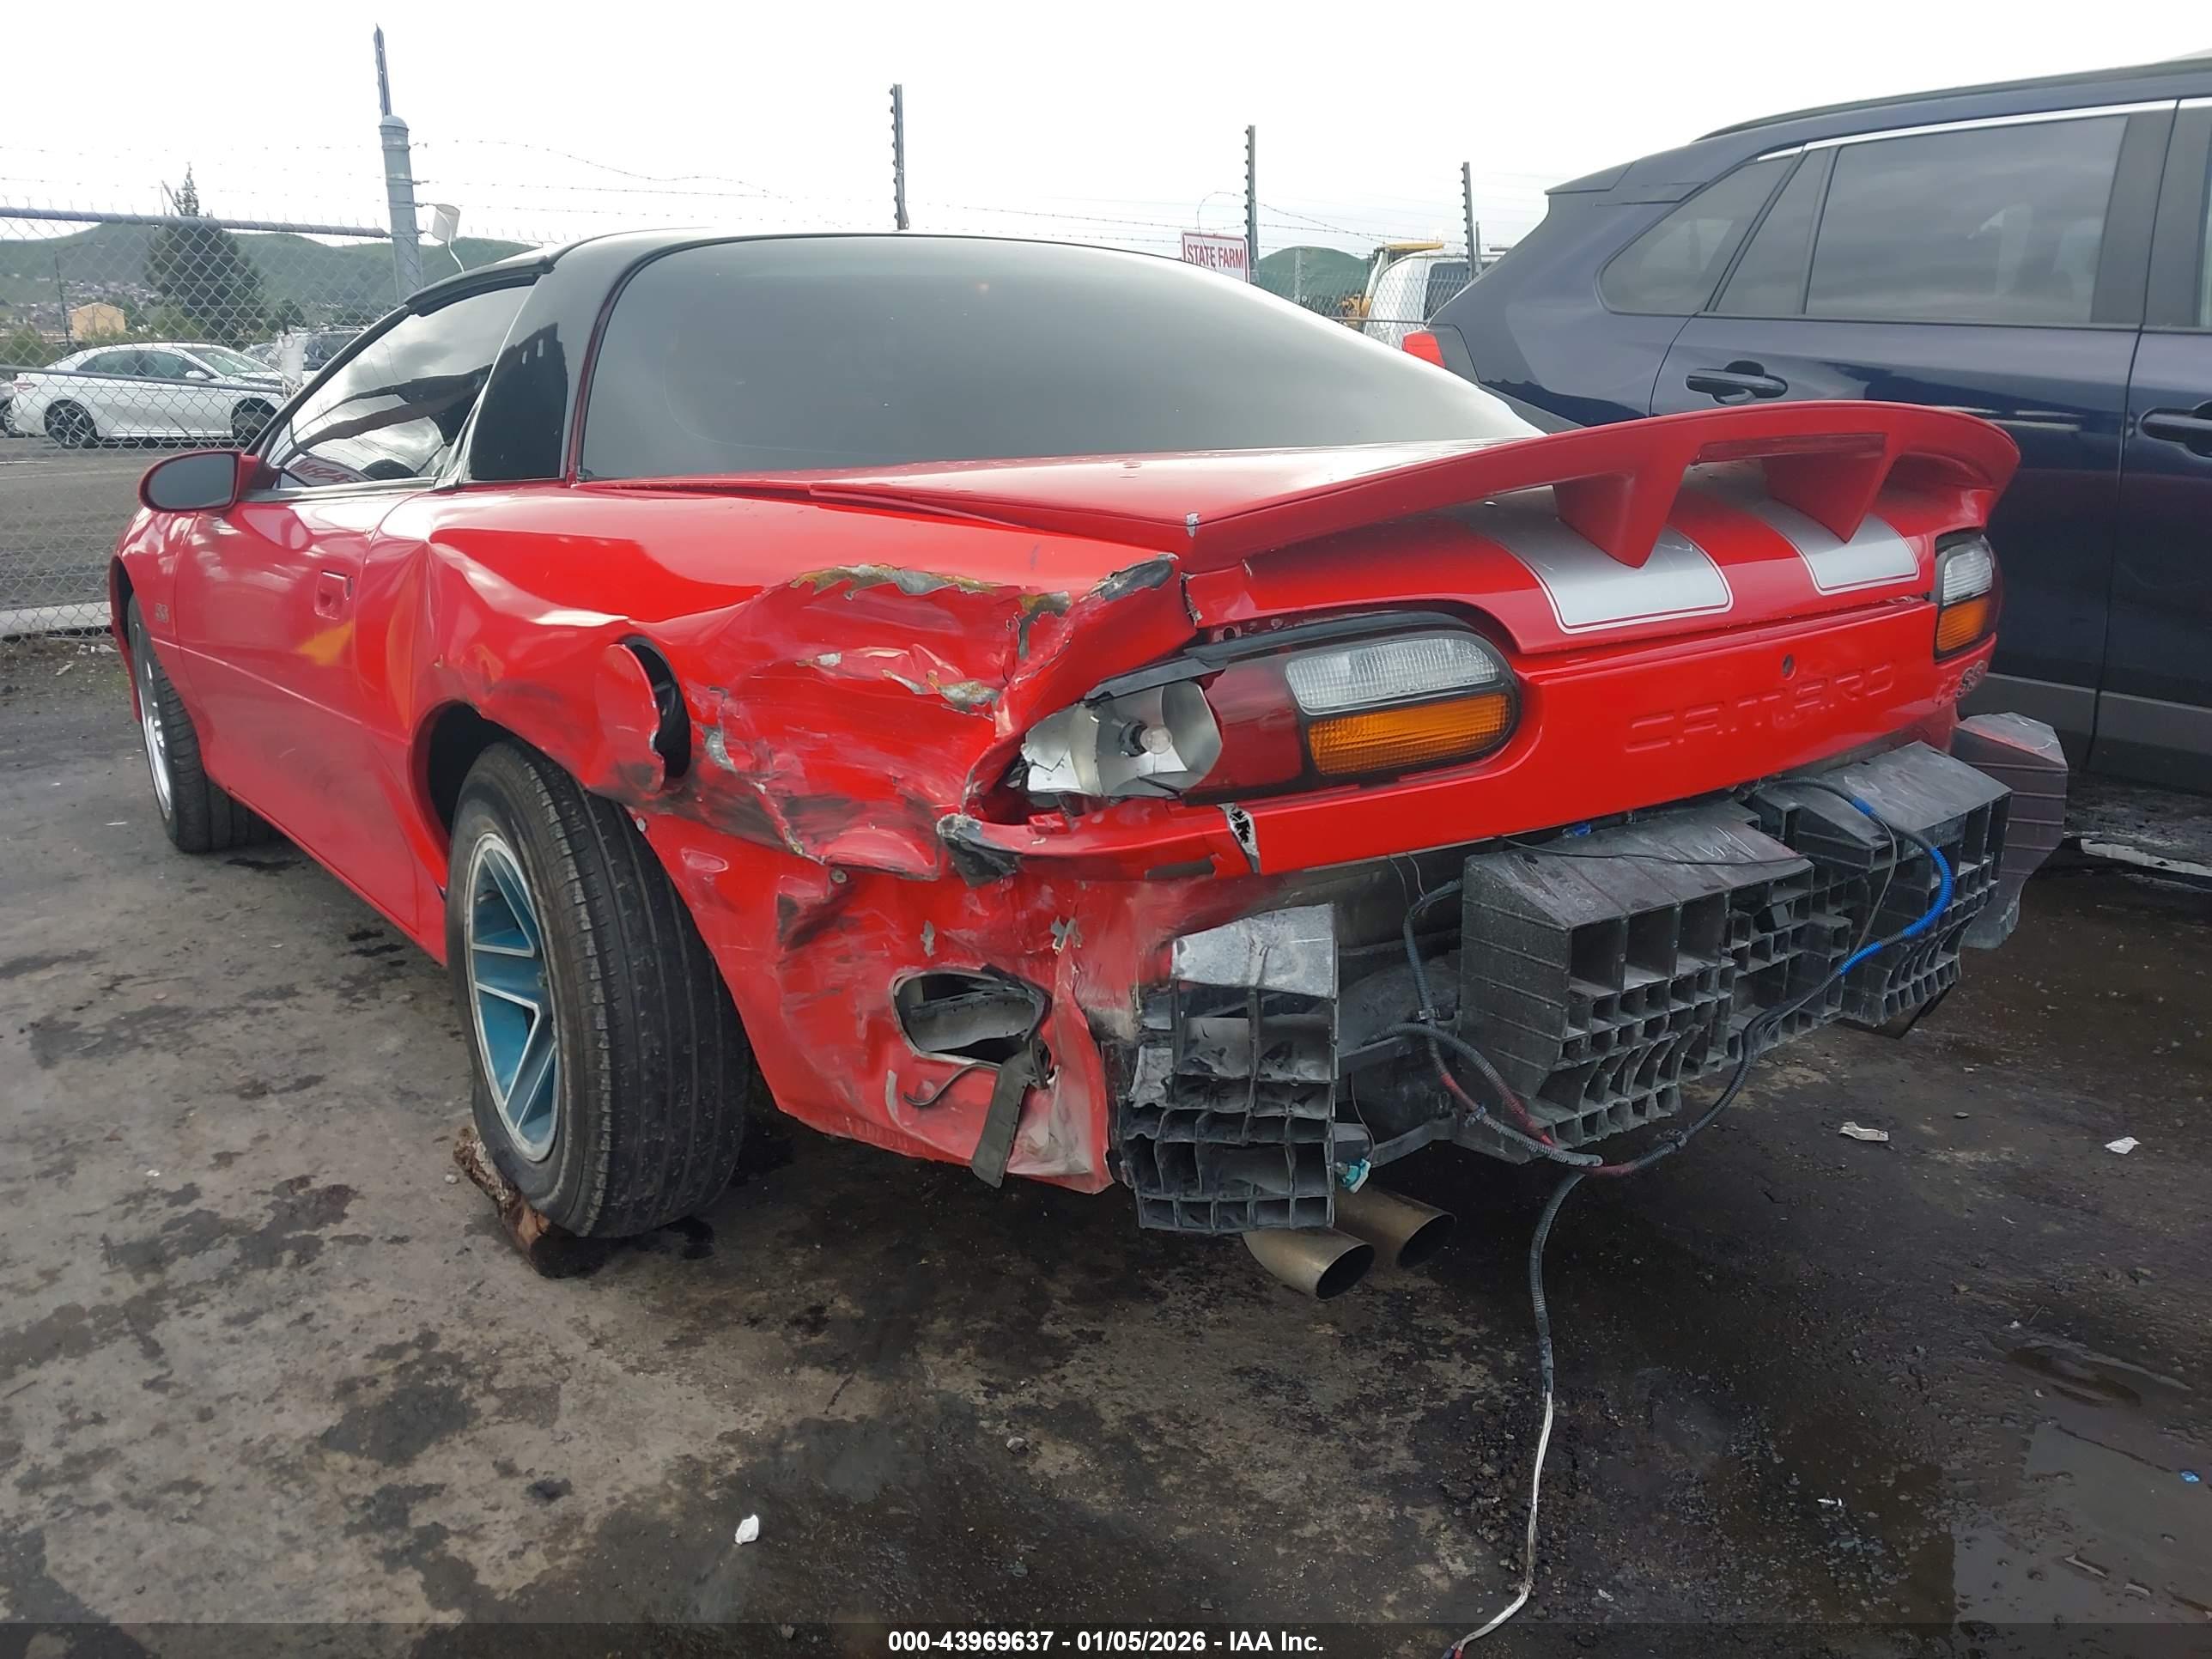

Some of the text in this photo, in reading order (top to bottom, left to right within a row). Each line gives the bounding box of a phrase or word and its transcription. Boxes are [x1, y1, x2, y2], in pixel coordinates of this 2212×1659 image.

[1187, 244, 1243, 269] STATE FARM
[1625, 659, 1894, 753] CAMARO
